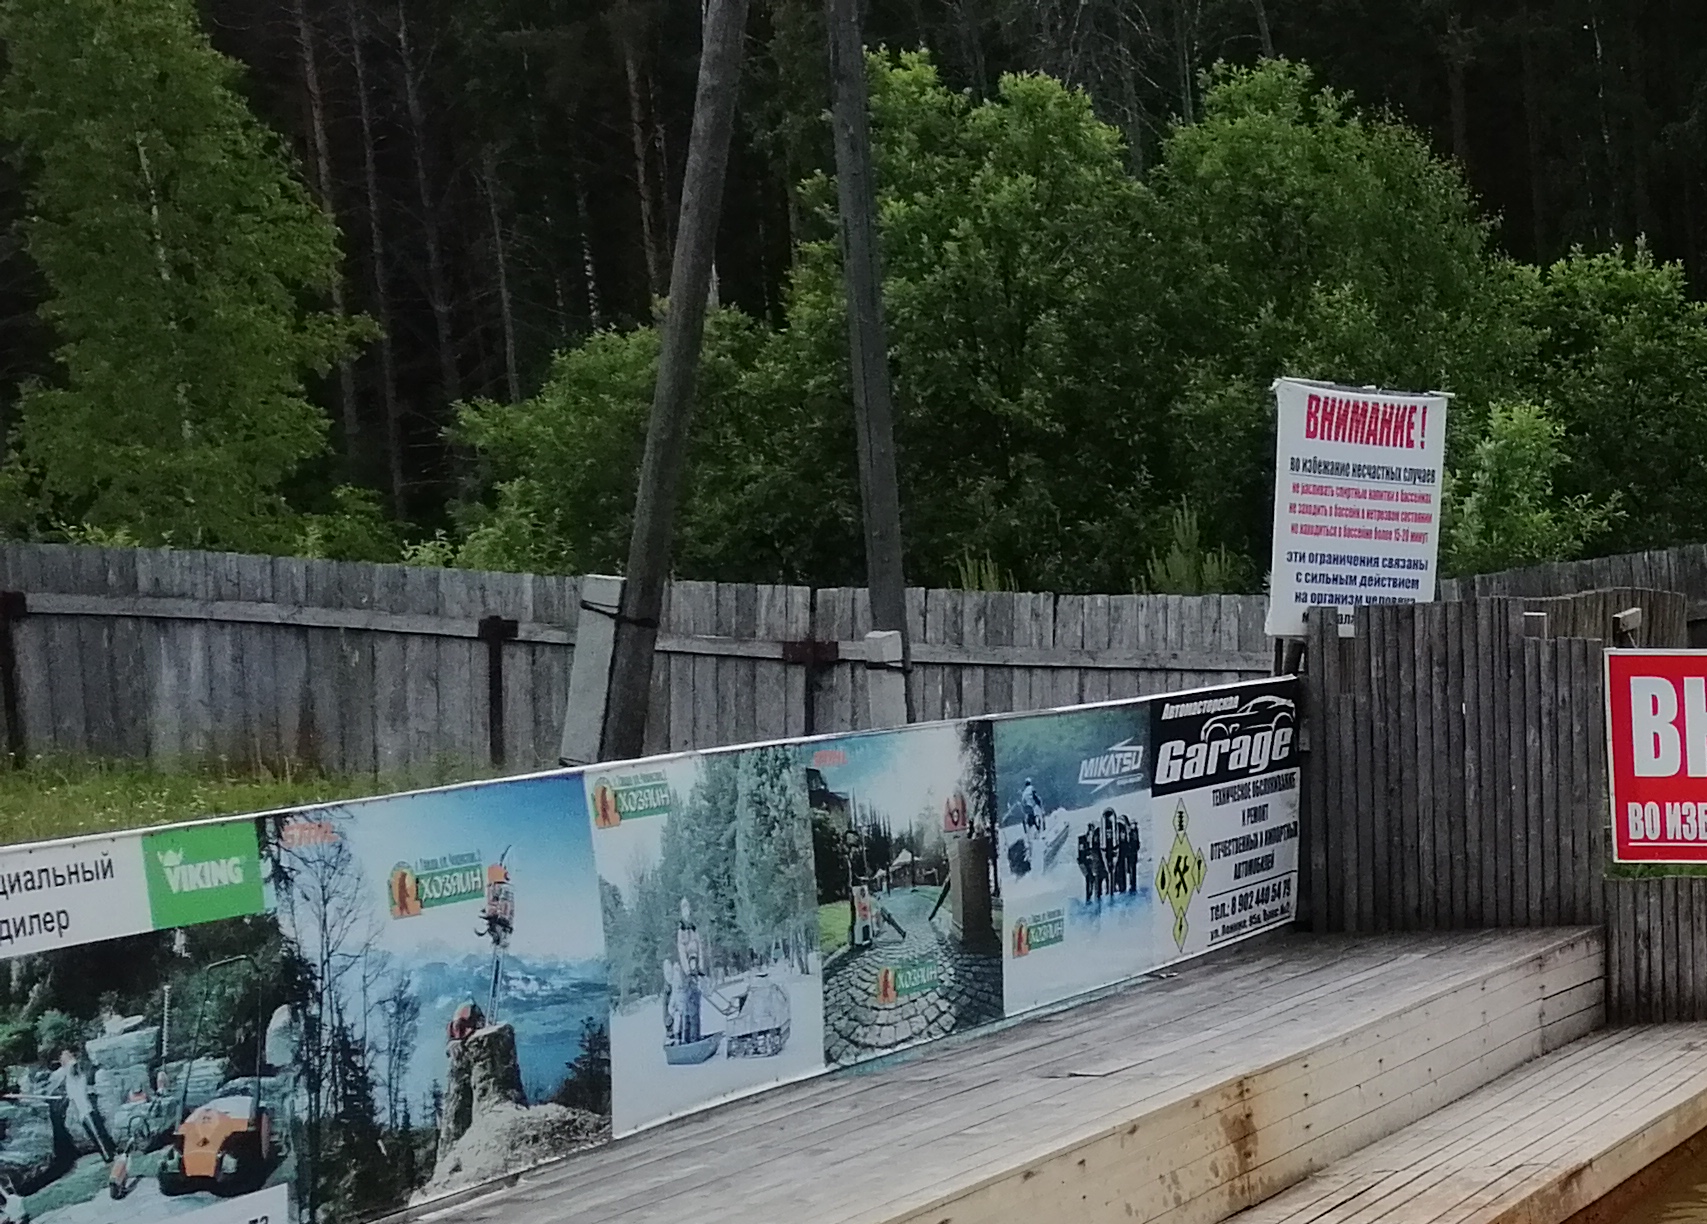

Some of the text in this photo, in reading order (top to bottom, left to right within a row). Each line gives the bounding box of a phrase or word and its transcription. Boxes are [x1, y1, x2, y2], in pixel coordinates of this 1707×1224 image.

[1290, 456, 1436, 485] во избежание несчастных случаев
[1289, 502, 1297, 514] не
[1286, 551, 1429, 571] эти ограничения связаны
[1296, 572, 1419, 590] с сильным действием
[1294, 591, 1308, 604] на
[1310, 592, 1363, 606] организм
[1079, 745, 1143, 785] MIKATSU
[1154, 727, 1294, 785] Garage
[619, 786, 669, 812] ХОЗЯИН
[1627, 801, 1661, 841] ВО
[163, 857, 243, 894] VIKING
[421, 868, 482, 902] ХОЗЯИН
[1231, 896, 1237, 916] 8
[1238, 890, 1254, 914] 902
[1254, 885, 1271, 907] 440
[1271, 881, 1282, 903] 54
[0, 909, 69, 946] дилер
